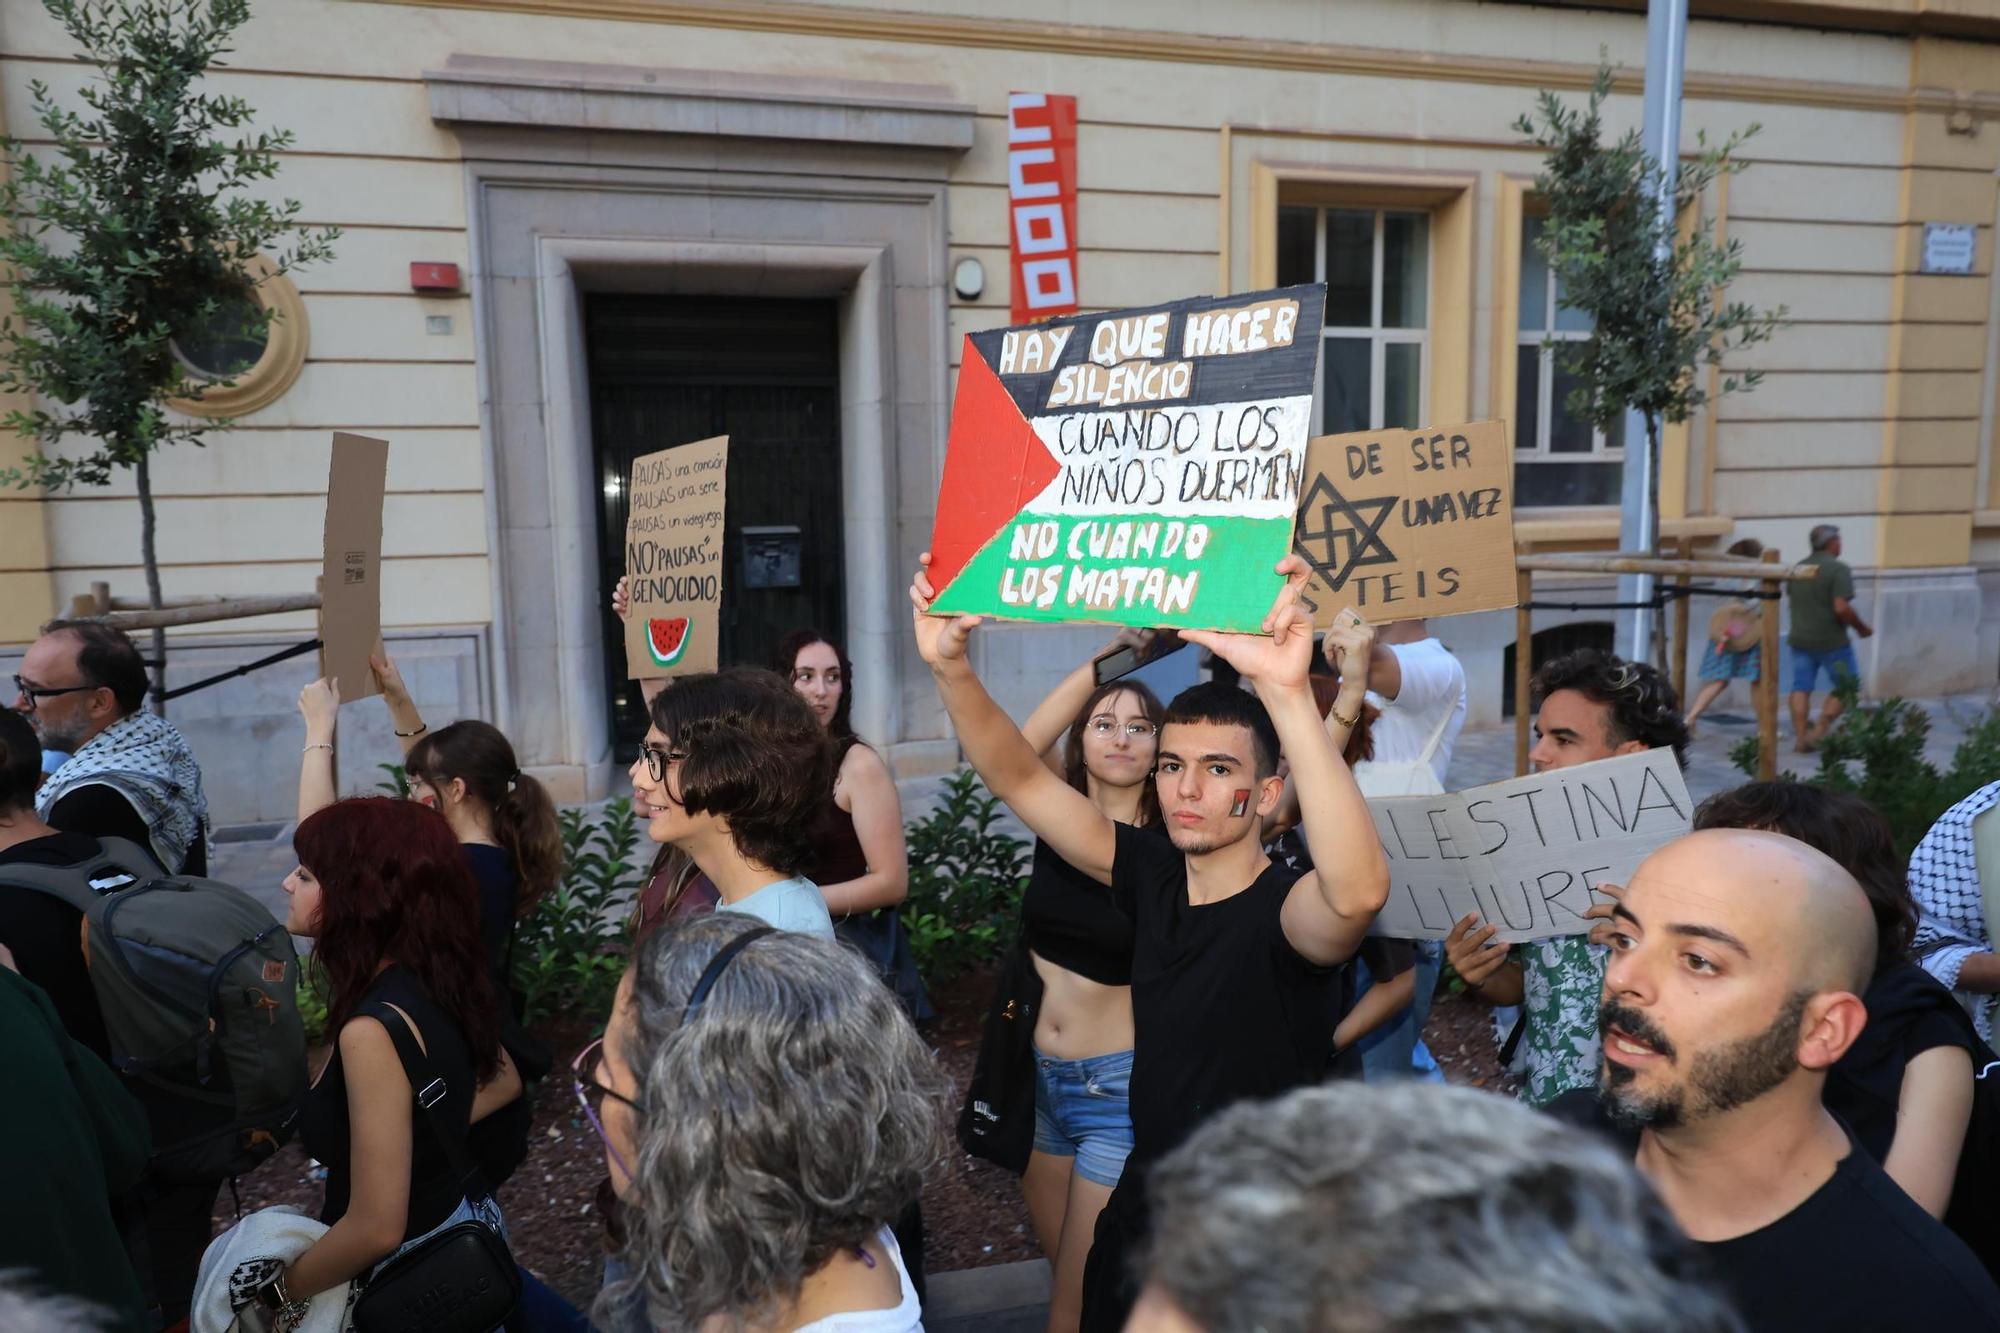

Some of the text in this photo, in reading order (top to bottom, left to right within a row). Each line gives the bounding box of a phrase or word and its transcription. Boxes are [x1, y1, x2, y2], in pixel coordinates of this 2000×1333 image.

[1008, 93, 1076, 310] CCOO
[1000, 306, 1296, 374] HAY QUE HACER
[1049, 362, 1190, 407] SILENCIO
[1058, 405, 1282, 455] CUANDO LOS
[635, 452, 725, 487] PAUSAS una canción
[1061, 451, 1302, 506] NIÑOS DUERMEN
[1345, 433, 1472, 481] DE SER
[633, 481, 719, 512] PAUSAS una serie
[1402, 487, 1502, 528] UNA VEZ
[631, 514, 667, 533] PAUSAS
[668, 517, 680, 529] un
[1009, 520, 1210, 561] NO CUANDO
[628, 540, 654, 576] NO
[708, 551, 719, 562] un
[1001, 564, 1199, 614] LOS MATAN
